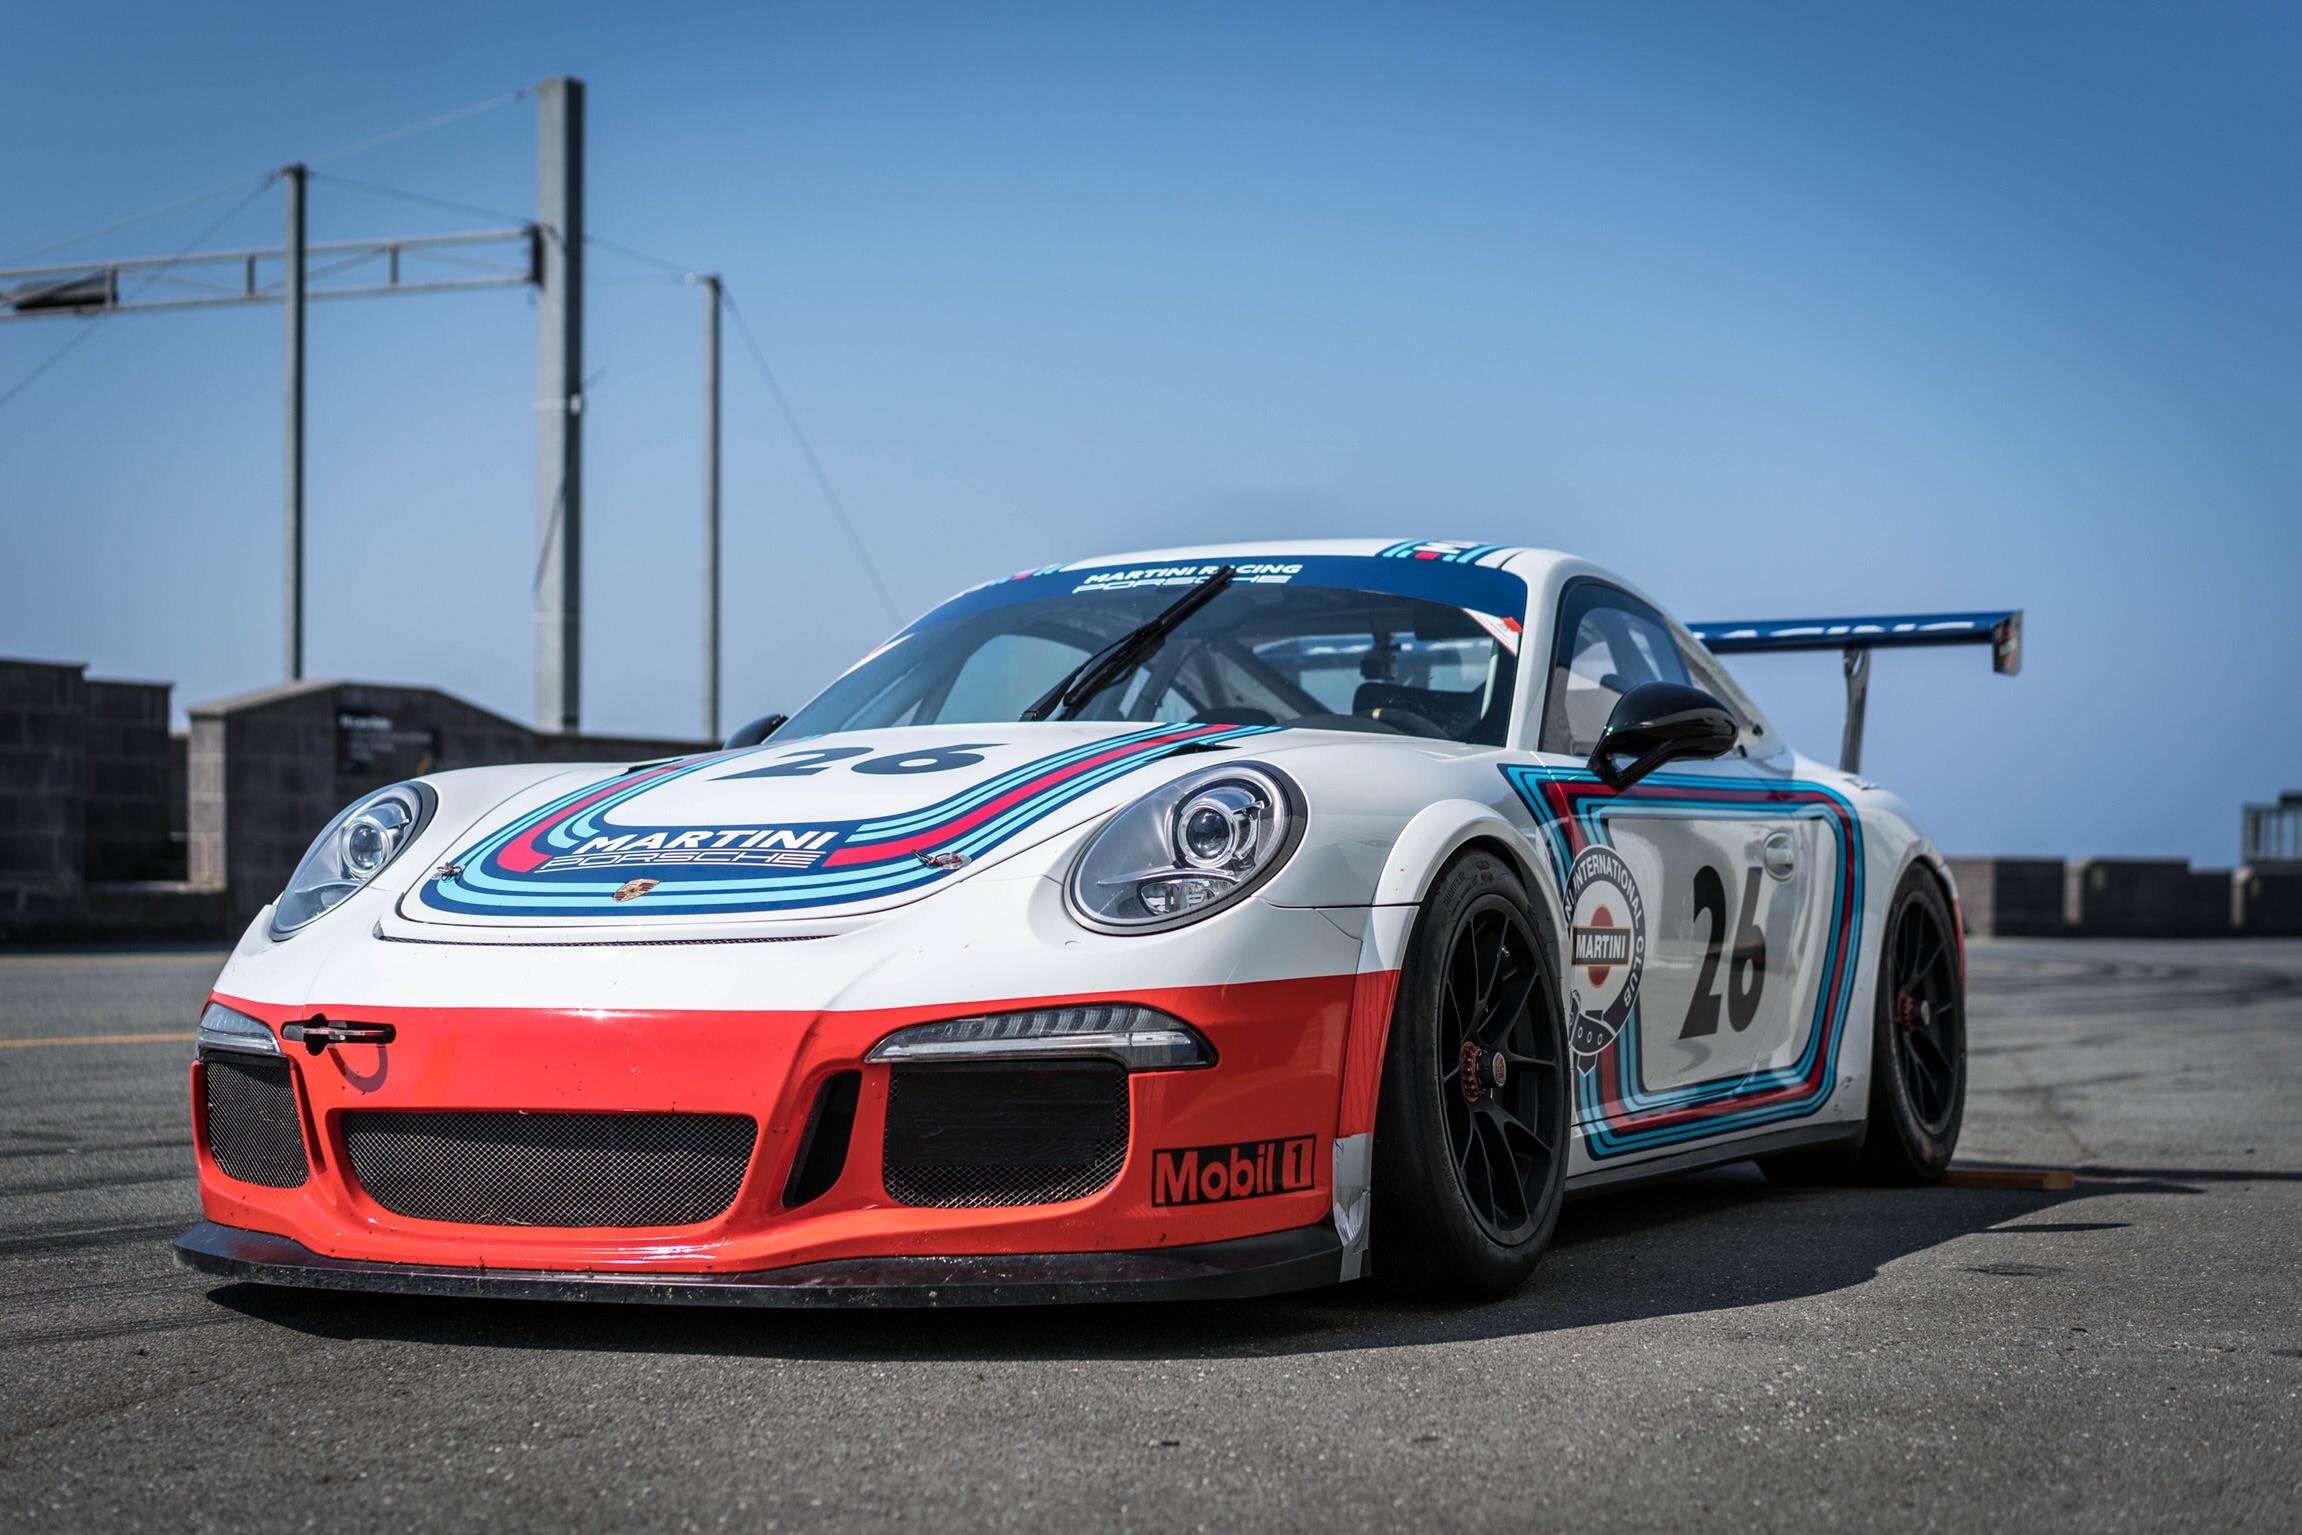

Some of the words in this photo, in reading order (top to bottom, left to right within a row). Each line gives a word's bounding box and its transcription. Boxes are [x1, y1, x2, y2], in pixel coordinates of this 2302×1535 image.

[1084, 567, 1197, 584] MARTINI
[1198, 564, 1303, 575] RCING
[705, 743, 1011, 781] 26
[572, 830, 839, 854] MARTINI
[536, 850, 826, 873] PORSCHE
[1573, 854, 1642, 929] INTERNATIONAL
[1624, 935, 1644, 1007] CLUB
[1576, 934, 1626, 959] MARTINI
[1679, 865, 1766, 1040] 26
[1155, 1143, 1275, 1204] Mobil
